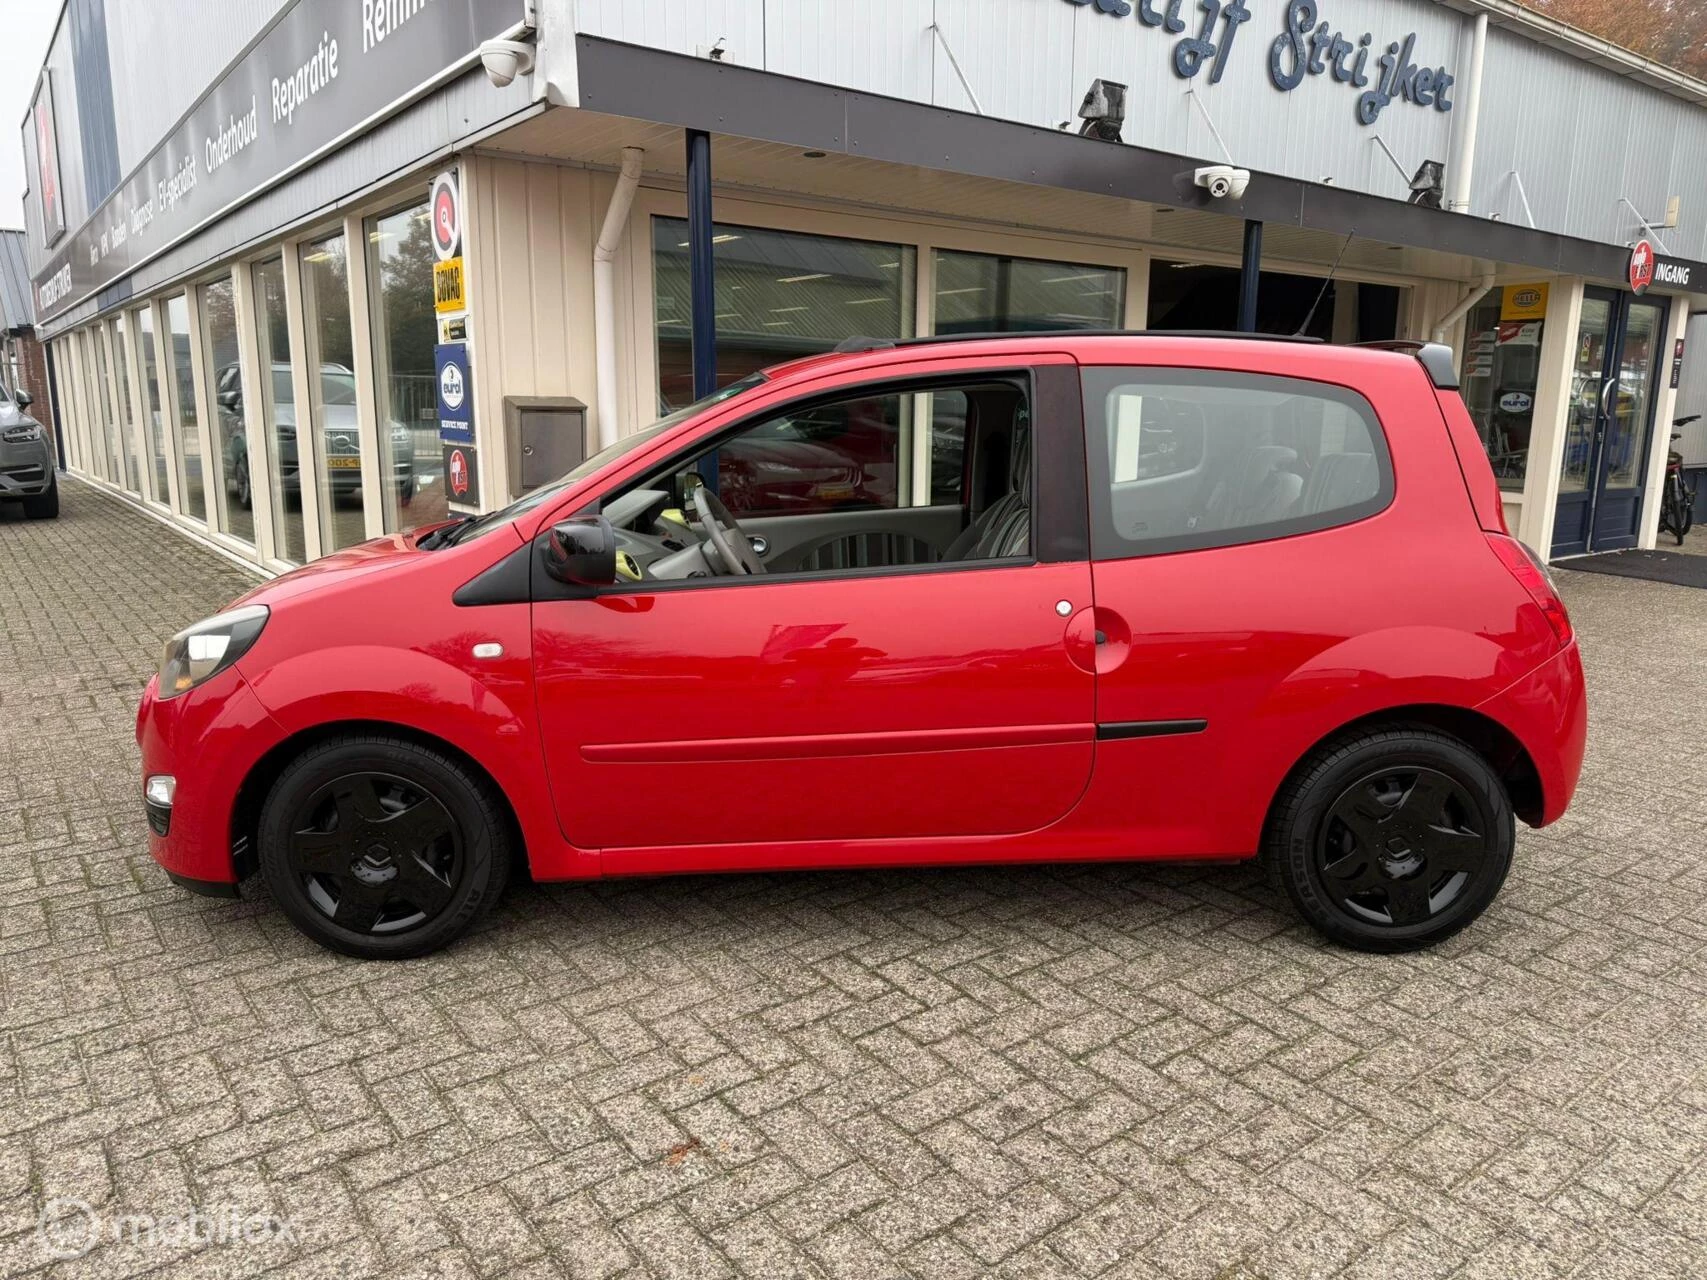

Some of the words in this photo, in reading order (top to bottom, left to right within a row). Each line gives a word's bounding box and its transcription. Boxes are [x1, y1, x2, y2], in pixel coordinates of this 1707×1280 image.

[1269, 0, 1454, 126] Strijker
[158, 153, 197, 212] EV-specialist
[205, 95, 257, 174] Onderhoud
[272, 31, 338, 125] Reparatie
[436, 266, 460, 303] BOVAG
[1655, 262, 1690, 285] INGANG
[443, 380, 461, 395] eurol
[1502, 399, 1530, 407] eurol
